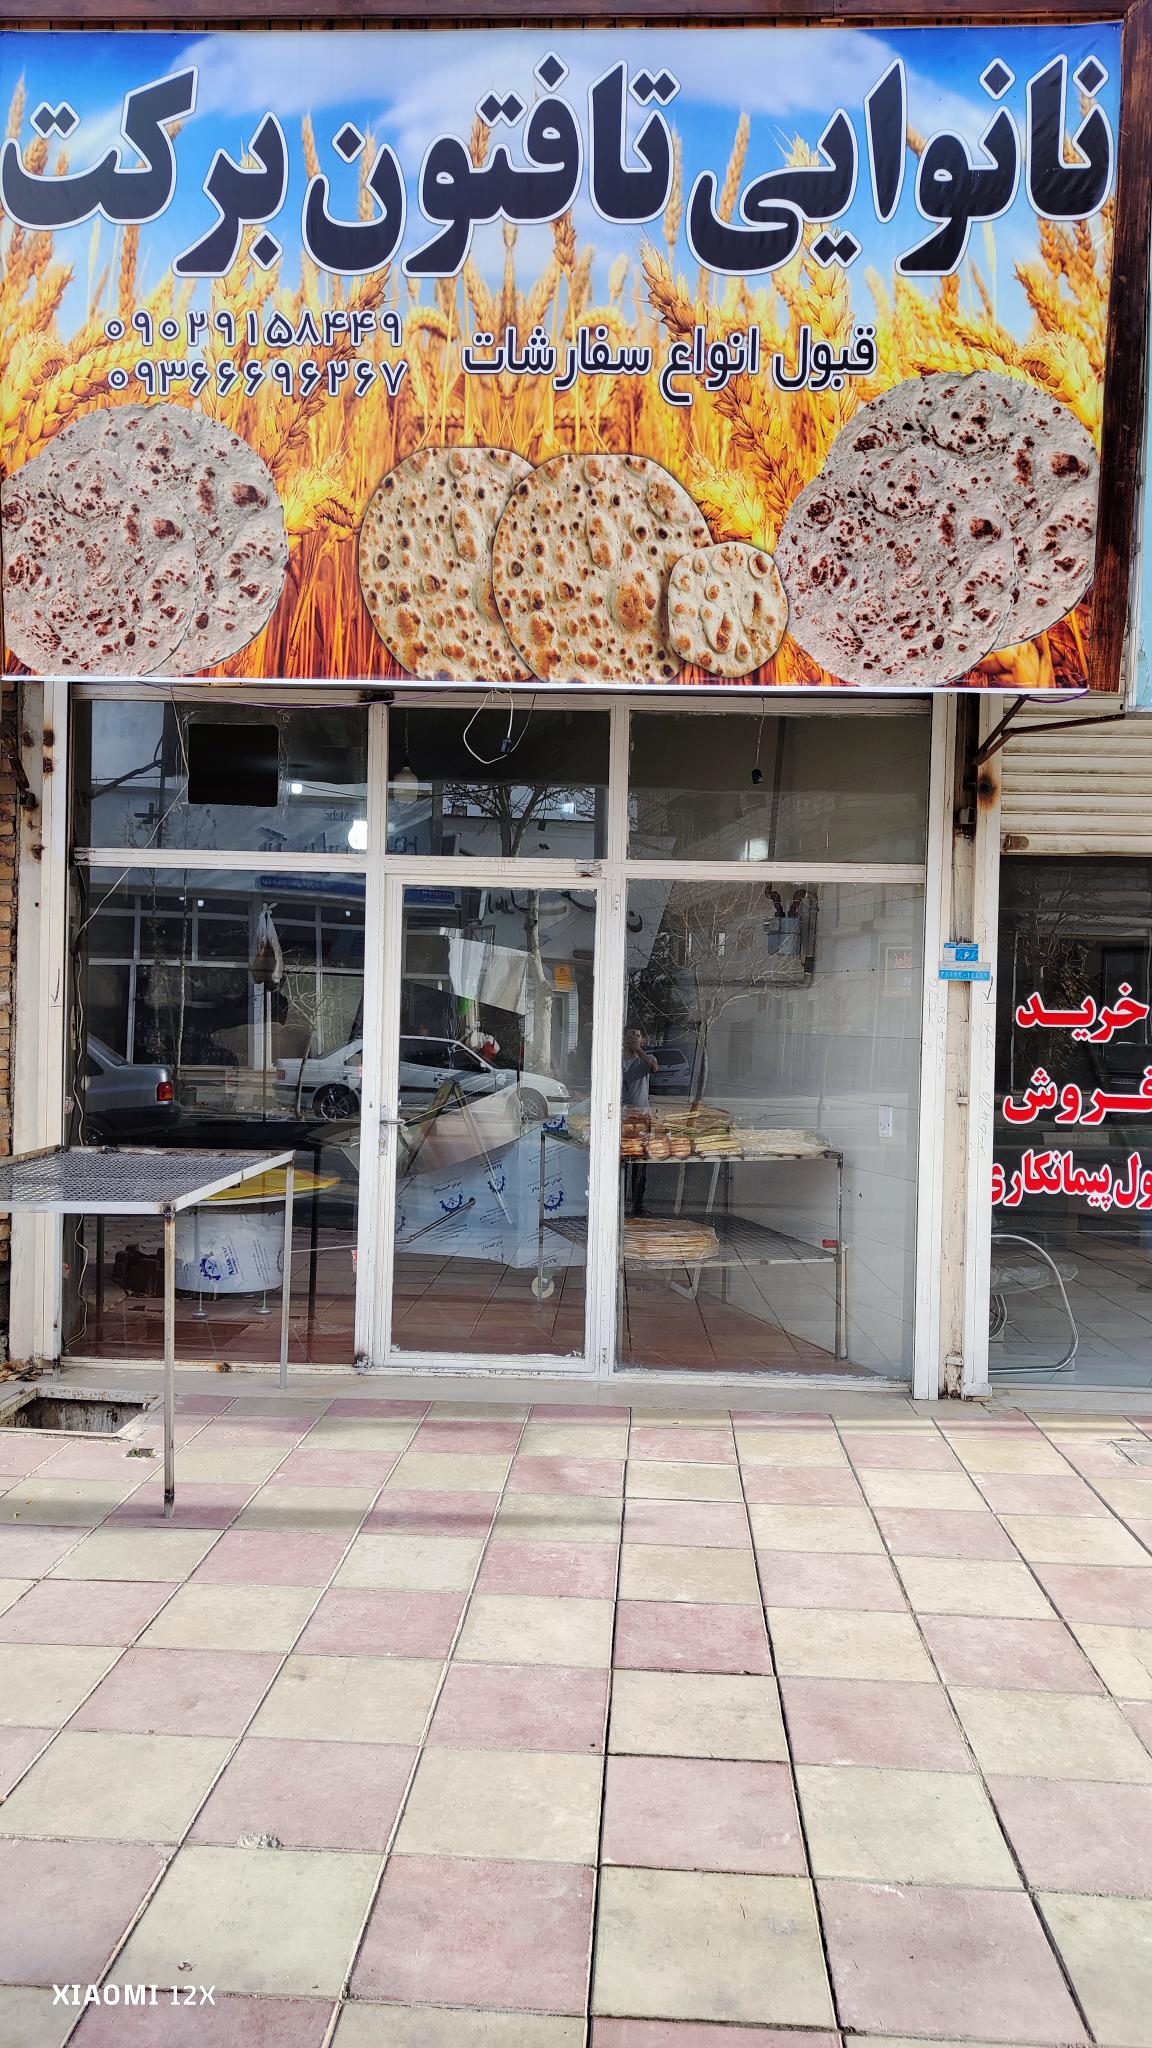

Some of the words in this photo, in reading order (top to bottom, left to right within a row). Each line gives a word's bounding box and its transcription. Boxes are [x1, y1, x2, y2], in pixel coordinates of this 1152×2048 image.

[0, 65, 290, 277] برکت
[302, 51, 681, 277] تافتون
[687, 54, 1114, 276] نانوایی
[104, 309, 403, 347] ۰۹۰۲۹۱۵۸۴۴۹
[461, 324, 652, 391] سفارشات
[772, 324, 878, 391] قبول
[107, 359, 408, 397] ۰۹۳۶۶۶۹۶۲۶۷
[659, 324, 759, 406] انواع
[1016, 983, 1149, 1043] خرید
